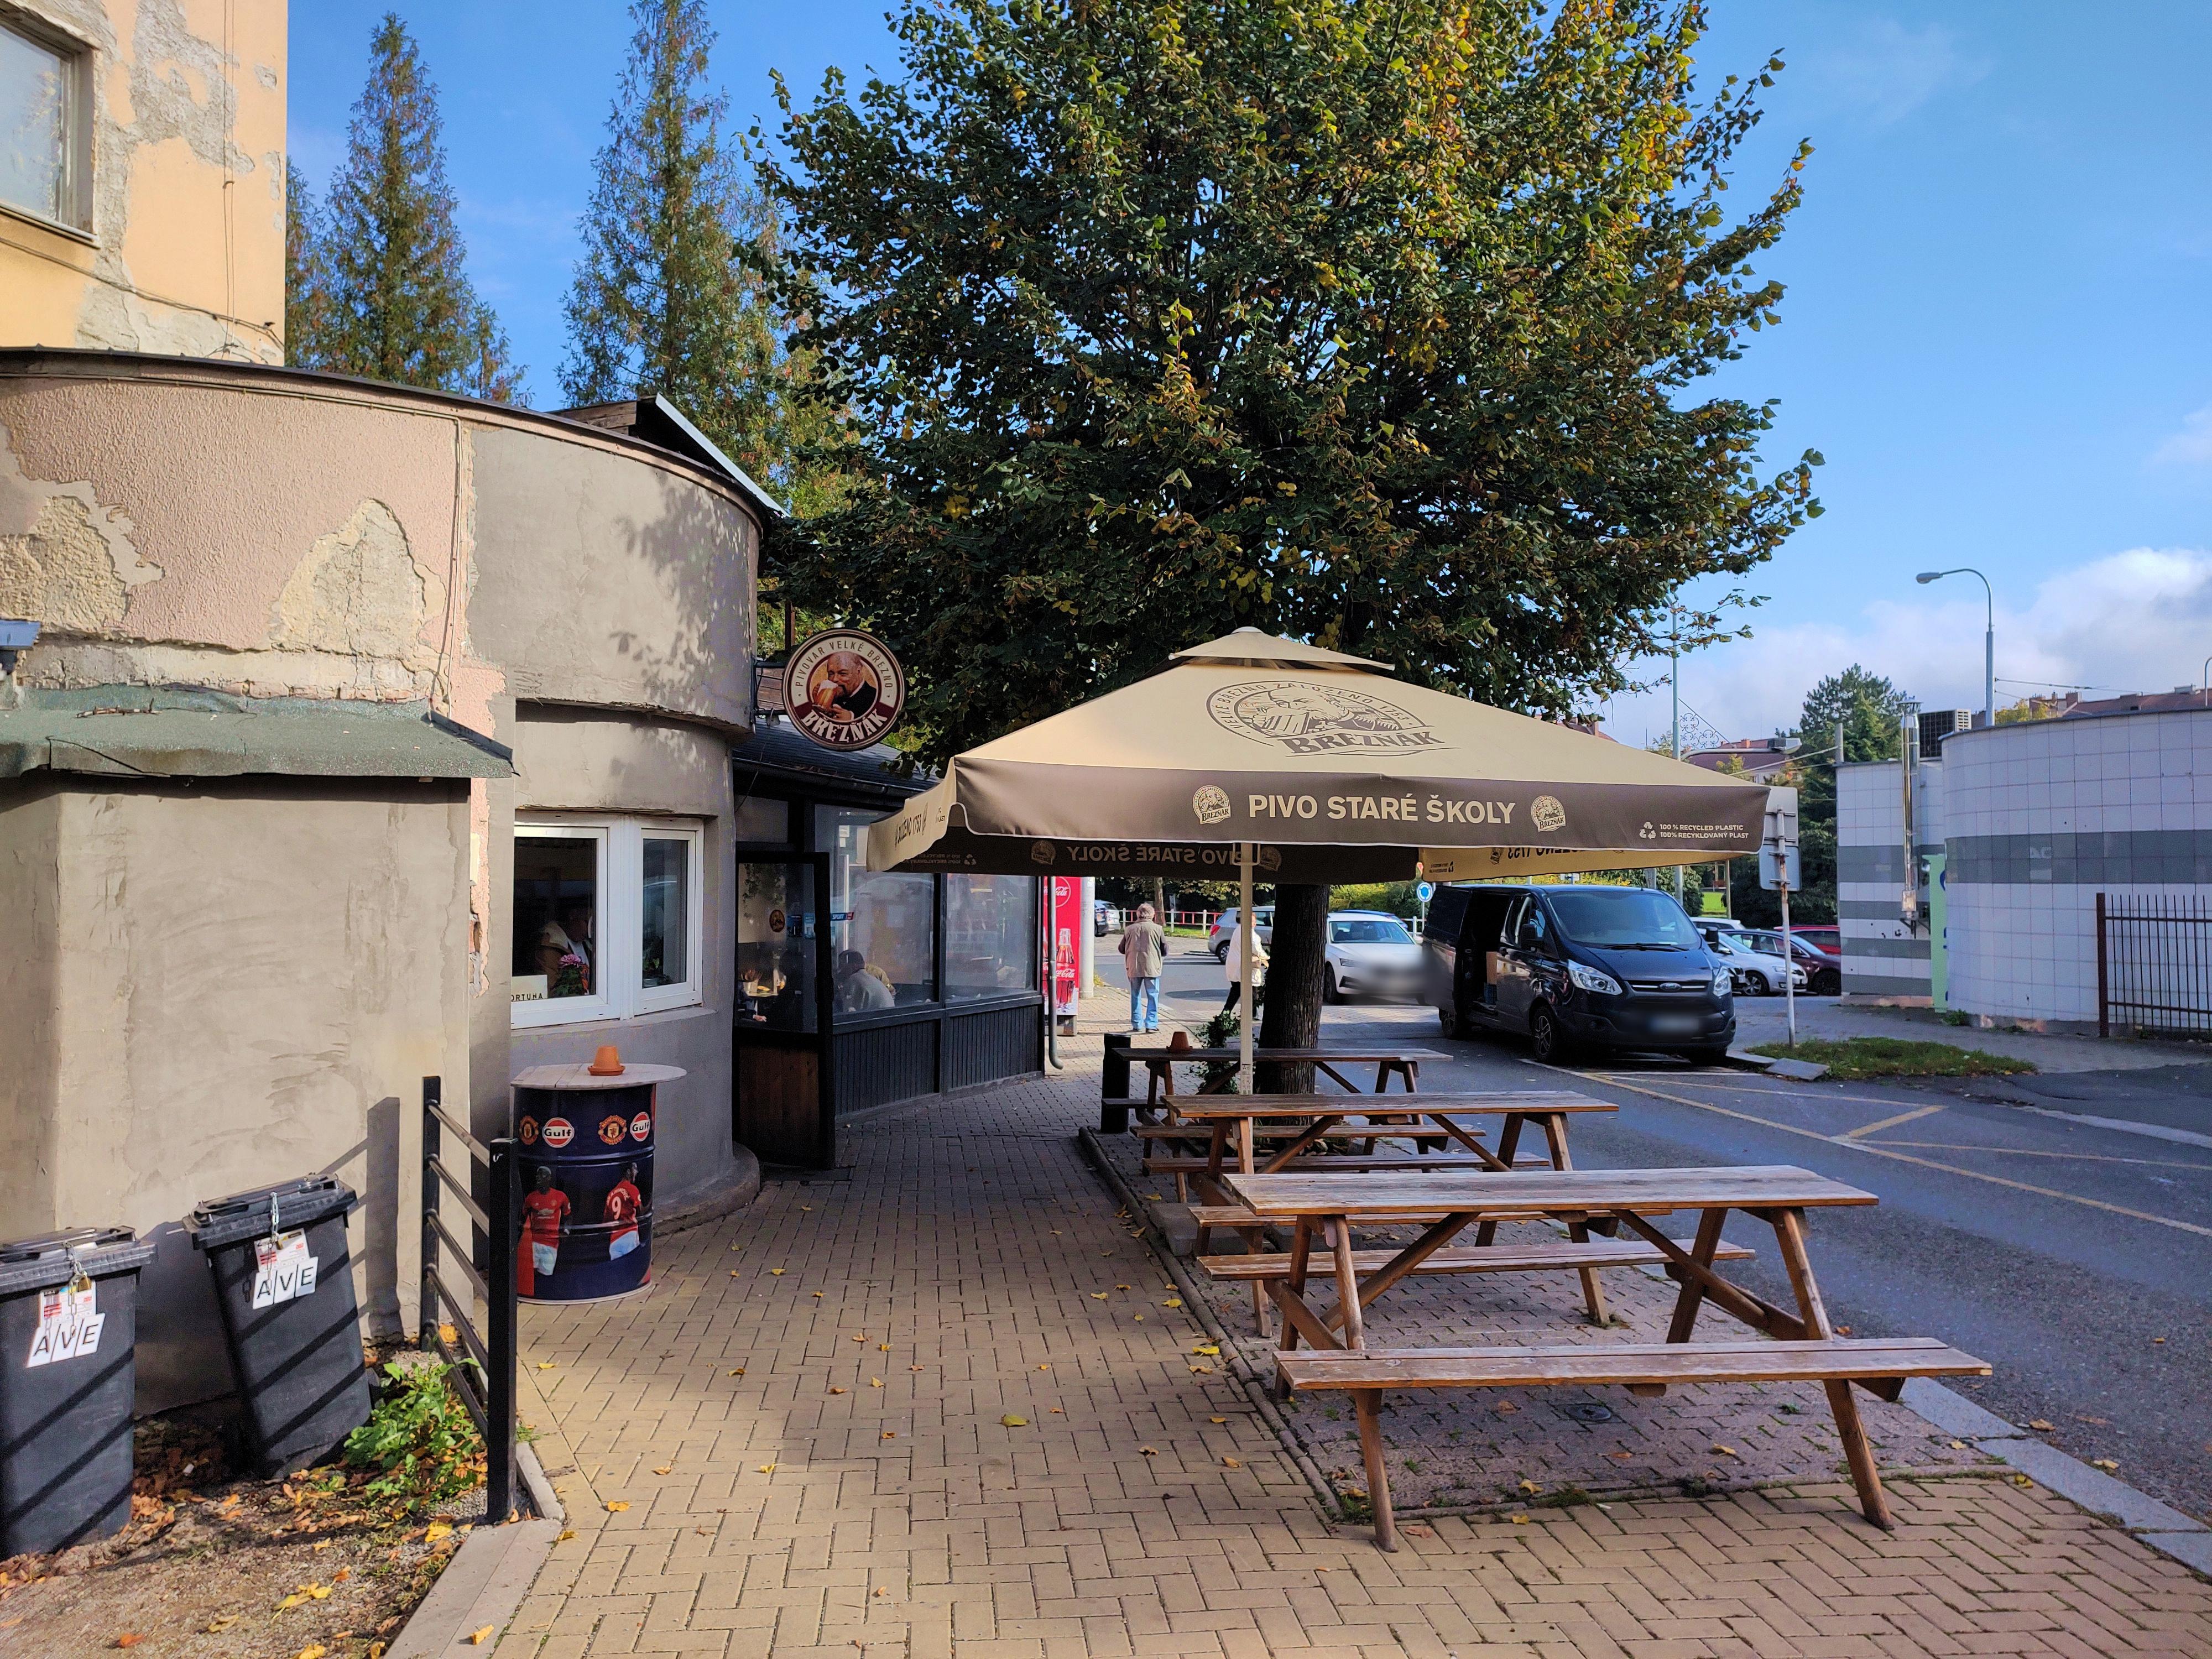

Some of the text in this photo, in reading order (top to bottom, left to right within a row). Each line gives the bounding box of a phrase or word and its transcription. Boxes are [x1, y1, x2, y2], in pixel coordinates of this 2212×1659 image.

[795, 640, 893, 687] PIVOVAR VELKÉ BŘEZNO
[802, 708, 888, 743] BŘEZŇÁK
[1380, 706, 1410, 720] 1753
[1249, 795, 1318, 818] PIVO
[1327, 793, 1418, 821] STARÉ
[1426, 794, 1516, 824] ŠKOLY
[511, 993, 543, 1002] ORTUNA
[544, 1128, 572, 1136] Gulf
[632, 1121, 649, 1132] Gulf
[612, 1196, 621, 1220] 9
[257, 1267, 314, 1299] AVE
[33, 1323, 99, 1357] AVE
